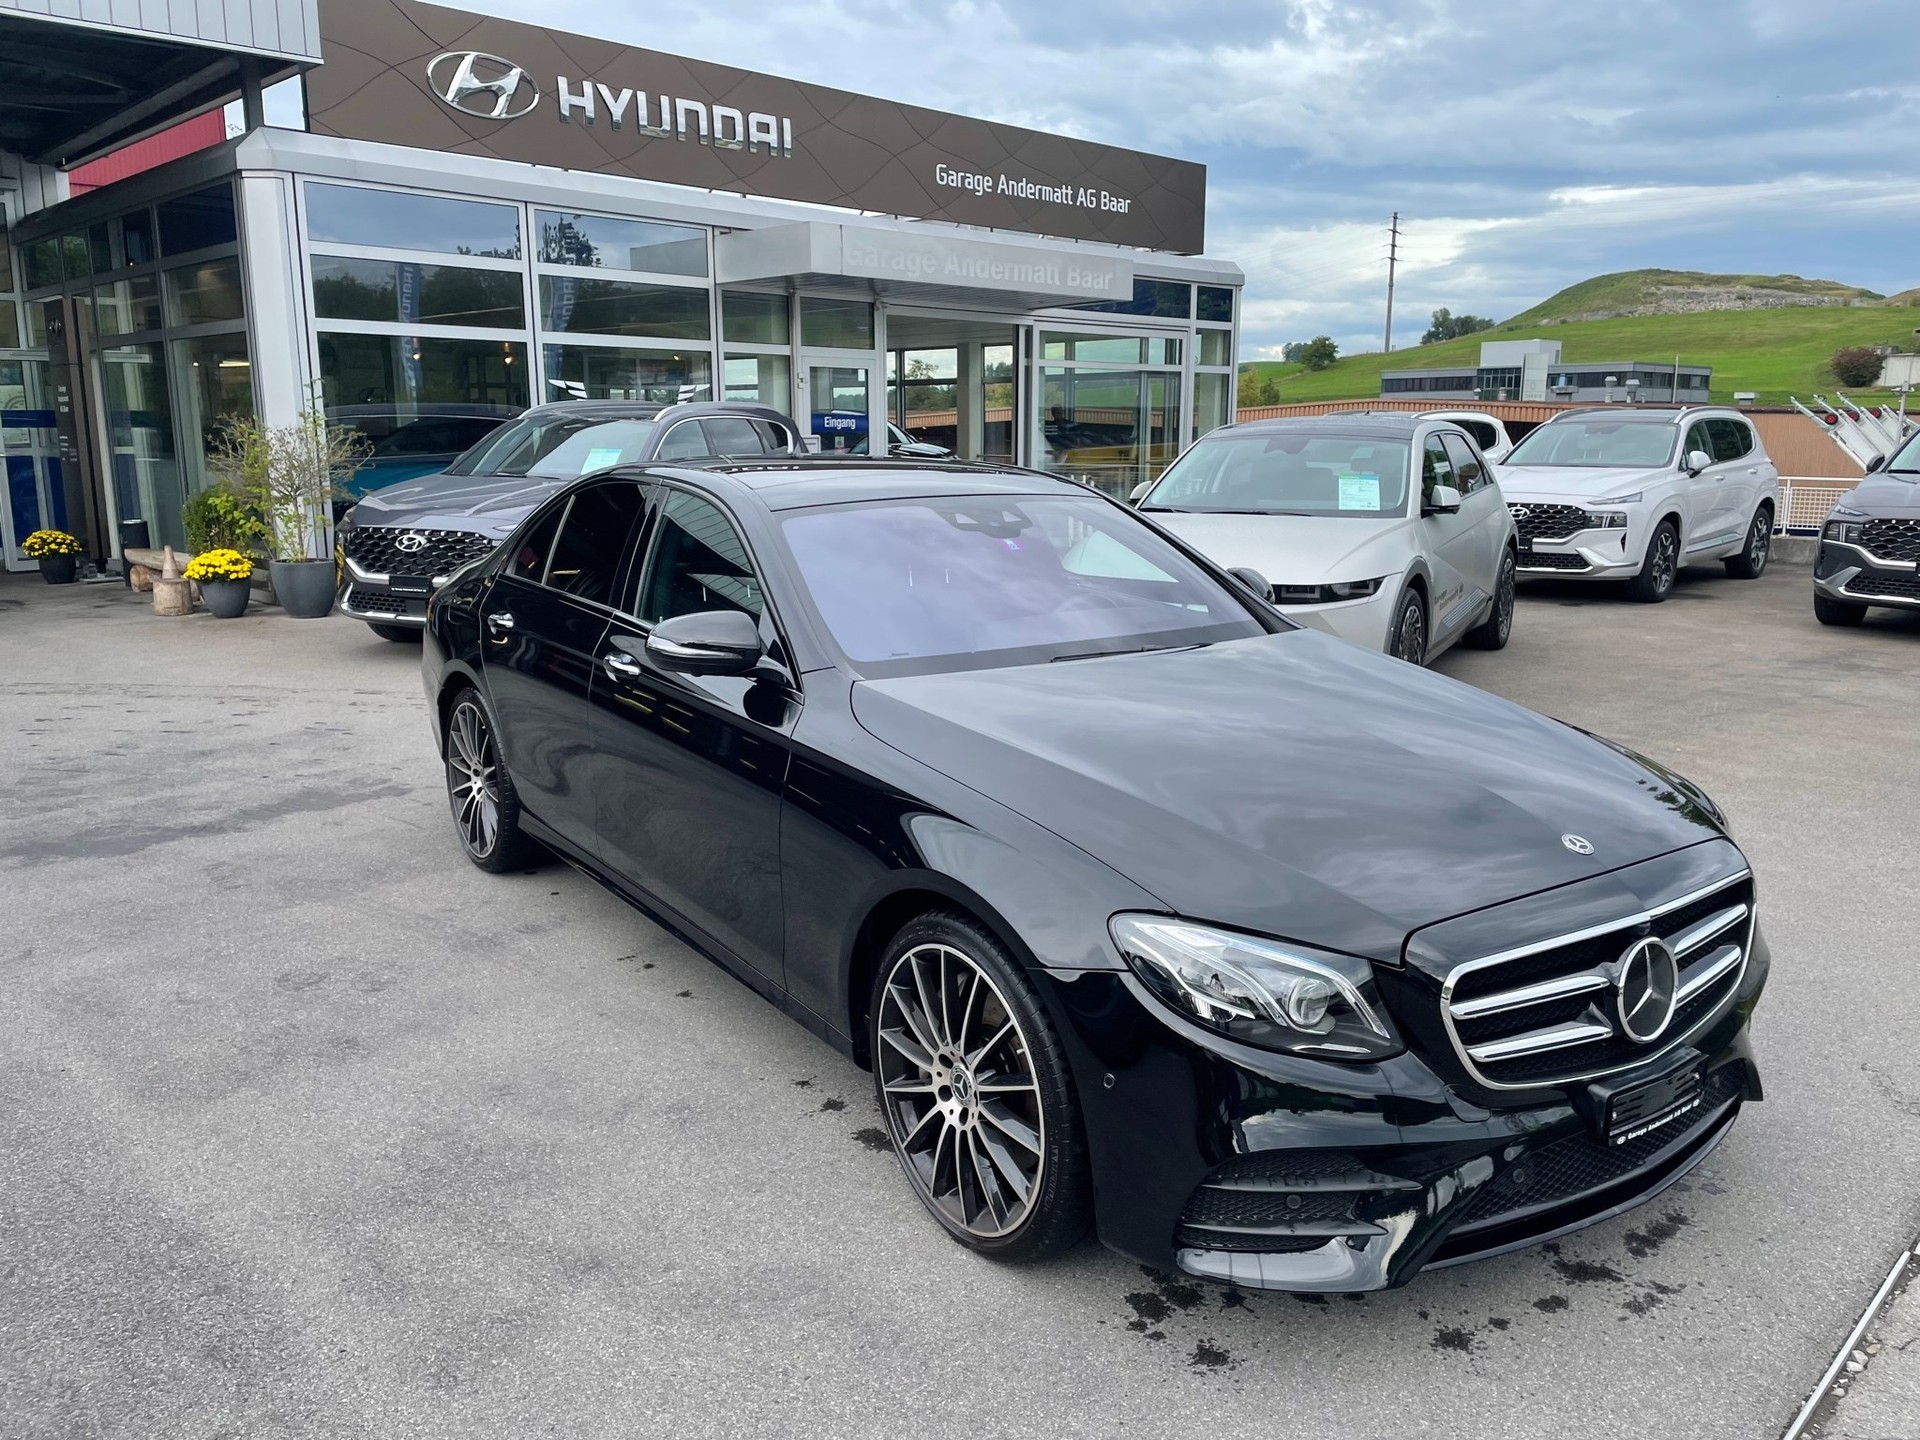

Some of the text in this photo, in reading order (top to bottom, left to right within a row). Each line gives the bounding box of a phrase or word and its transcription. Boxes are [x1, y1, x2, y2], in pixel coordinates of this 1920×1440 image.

[557, 76, 792, 158] HYUNDAI
[935, 163, 1132, 214] Garage Andermatt AG Baar
[847, 246, 1114, 290] Garage Andermatt Baar
[824, 416, 856, 430] Eingang
